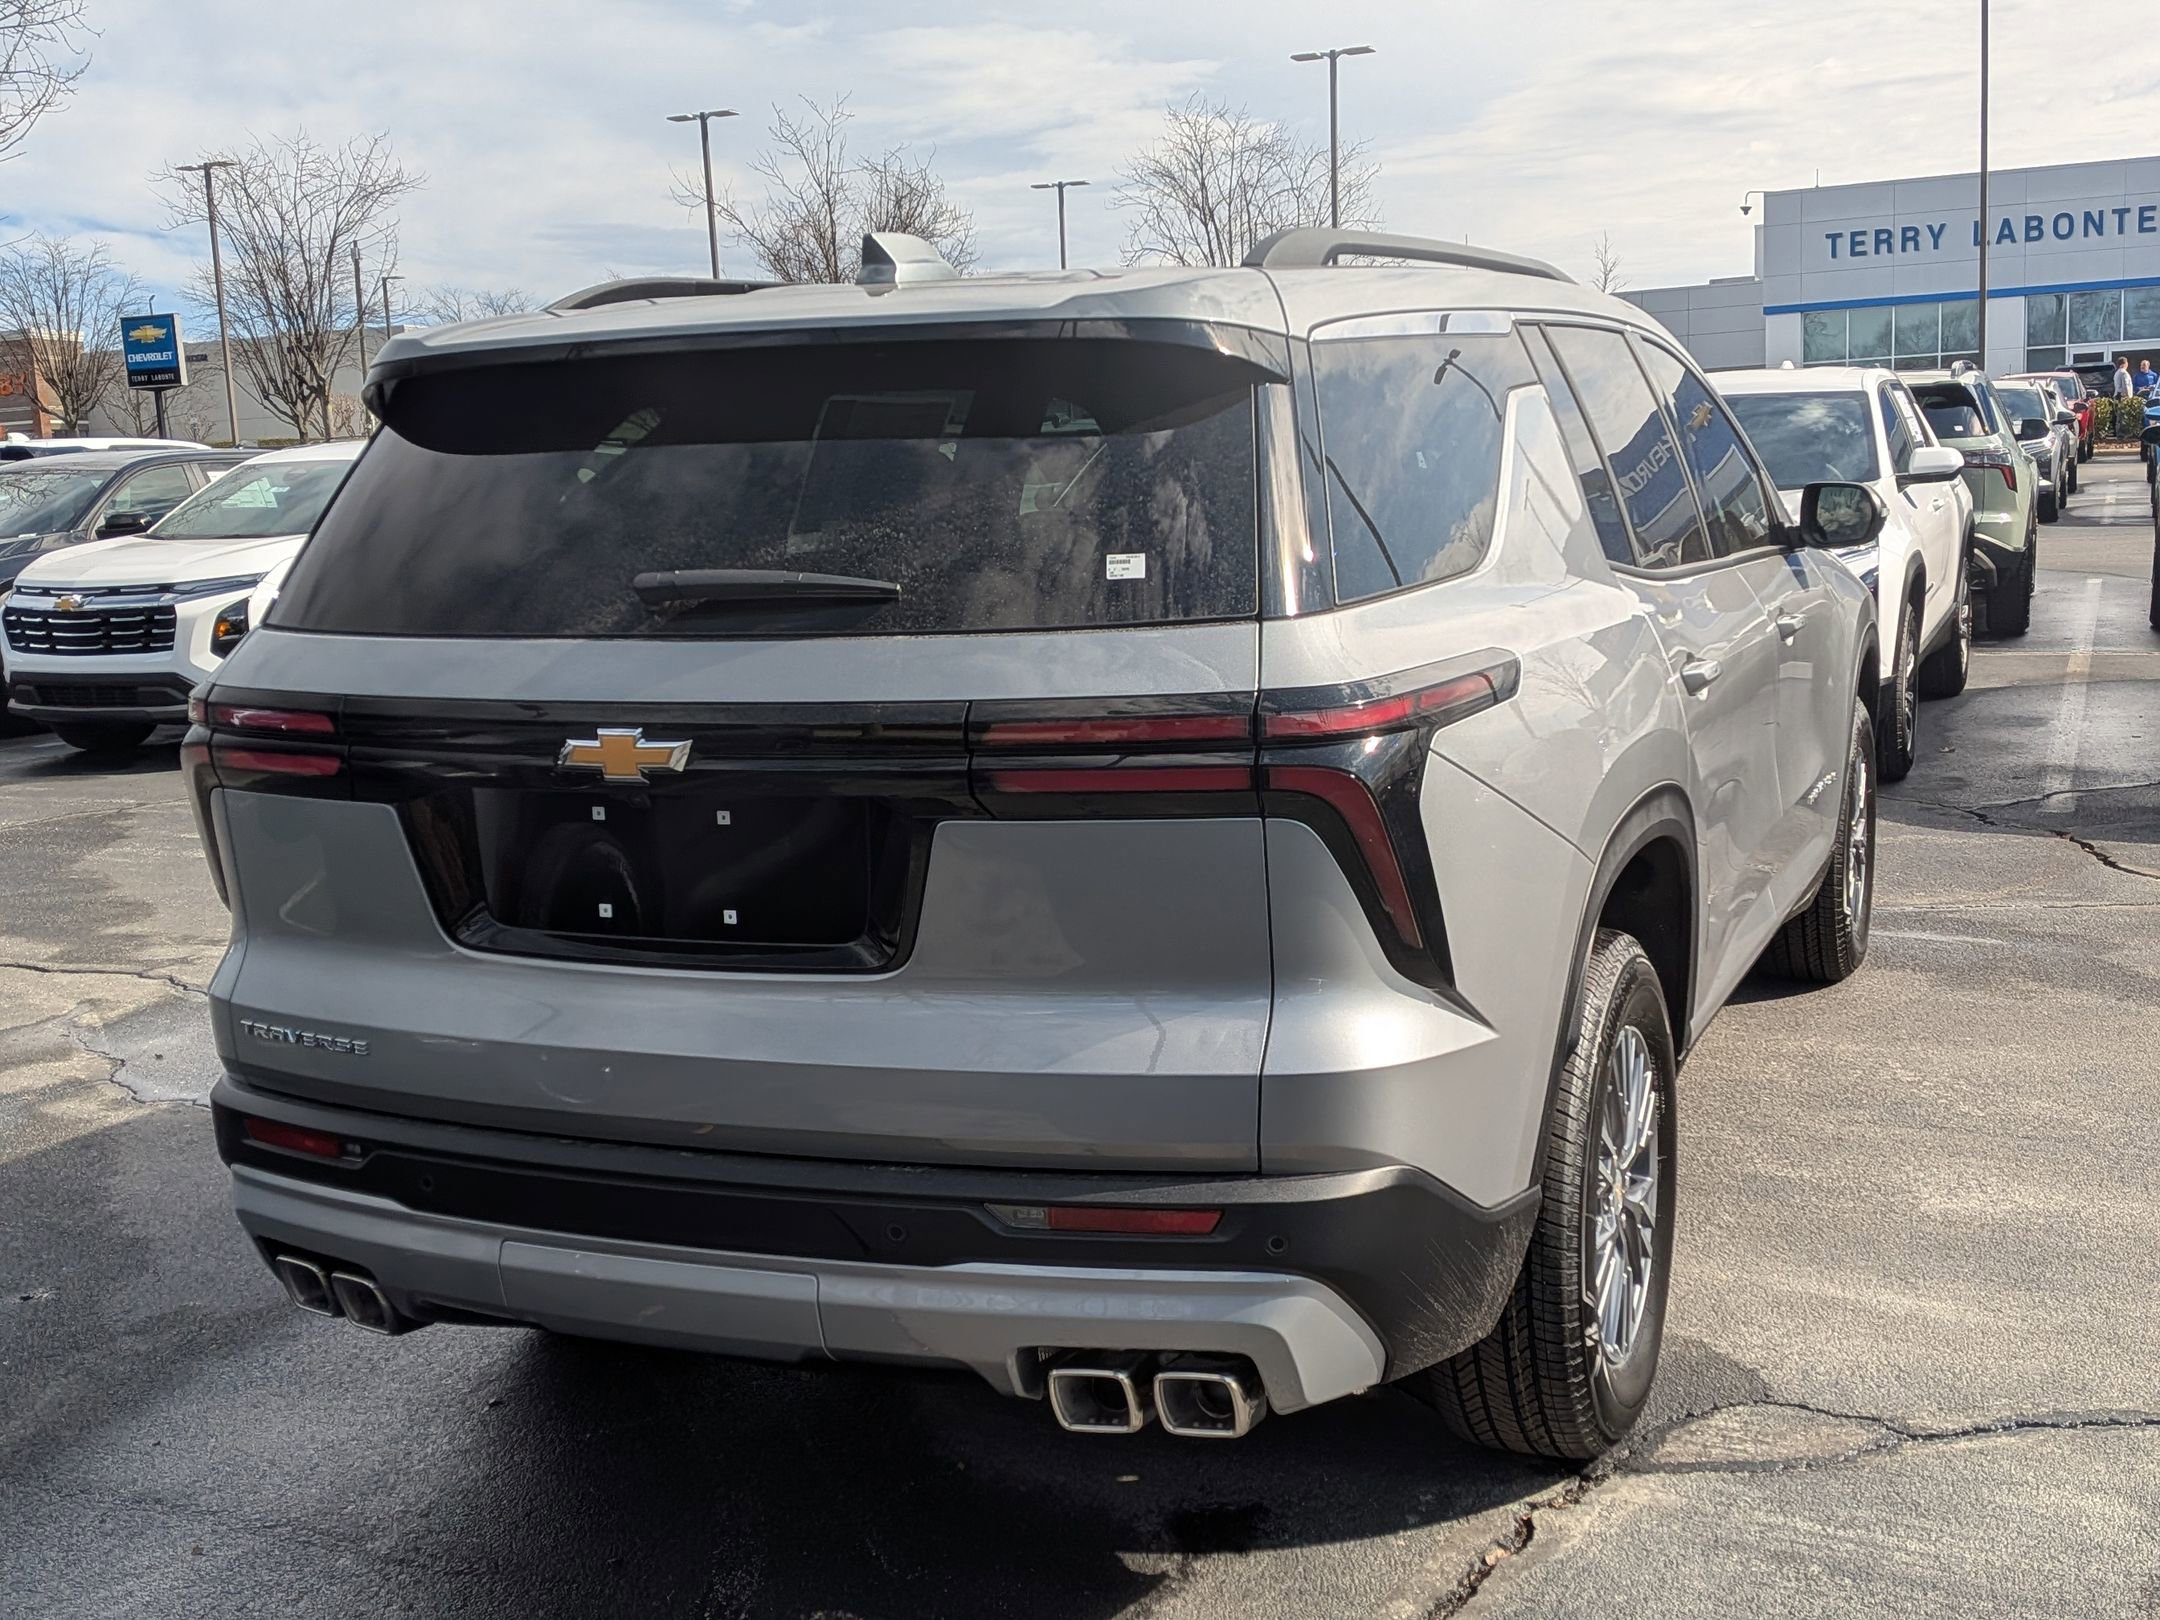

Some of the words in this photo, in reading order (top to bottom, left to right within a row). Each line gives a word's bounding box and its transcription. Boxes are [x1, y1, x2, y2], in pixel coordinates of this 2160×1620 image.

[1825, 222, 1947, 259] TERRY
[1972, 205, 2158, 247] LABONTE
[127, 351, 173, 363] CHEVROLET
[239, 1019, 369, 1055] TRAVERSE
